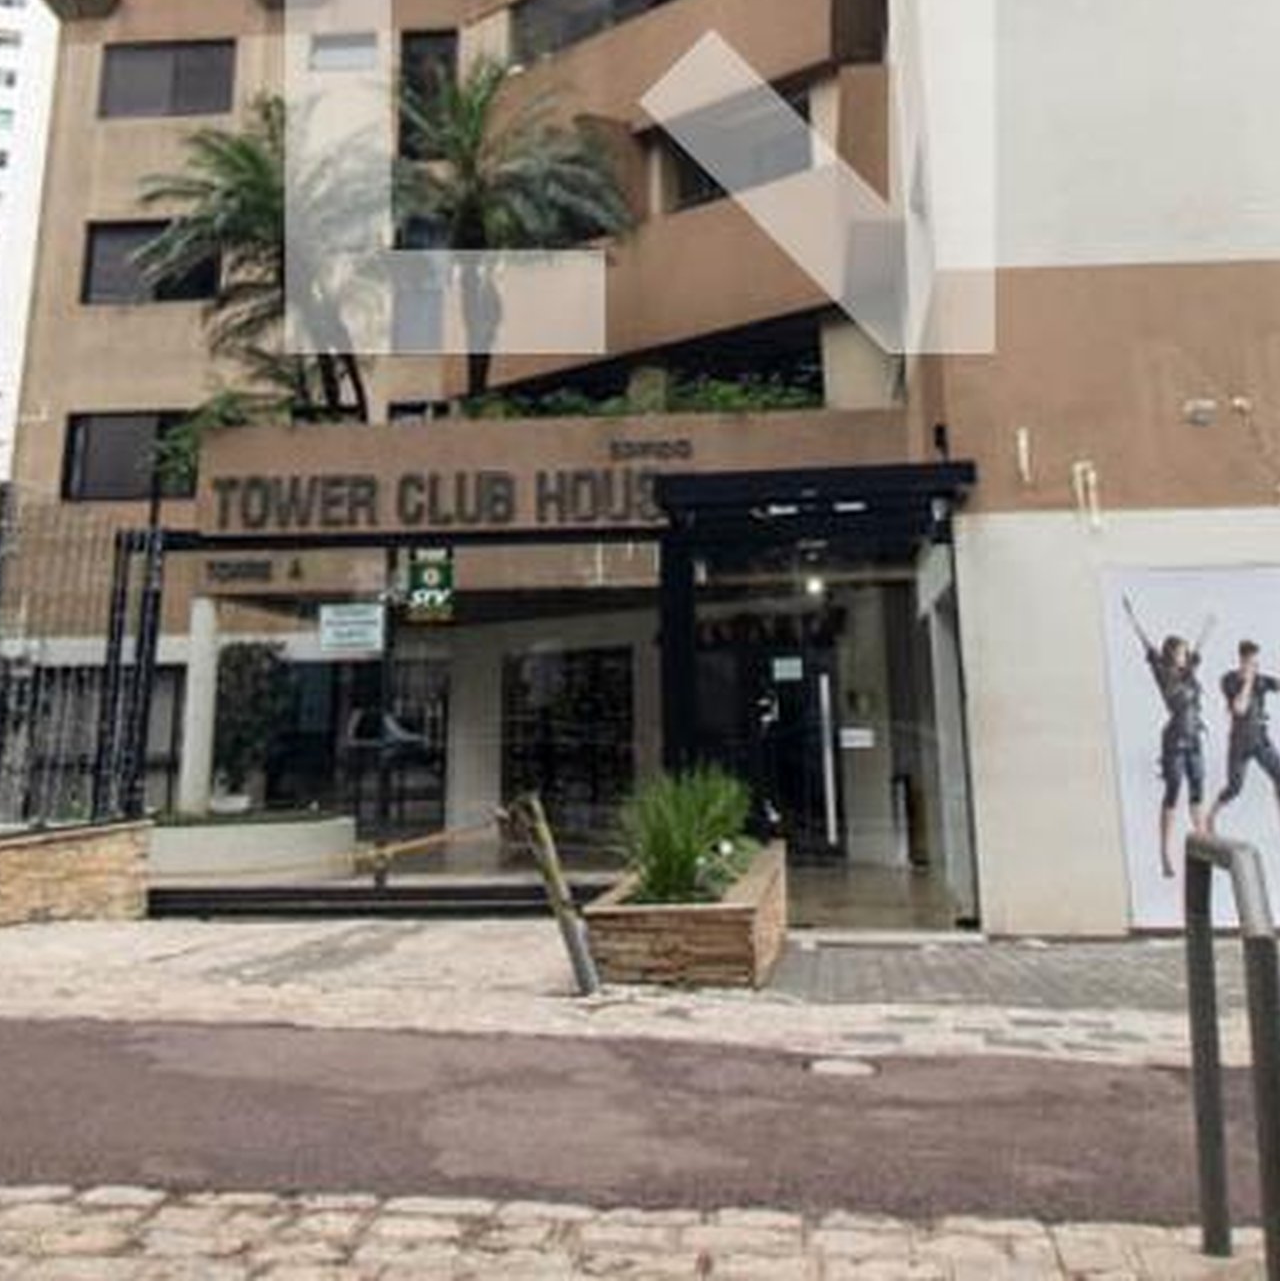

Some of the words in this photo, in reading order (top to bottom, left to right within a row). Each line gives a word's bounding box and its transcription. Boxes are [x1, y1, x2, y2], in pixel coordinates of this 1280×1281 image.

[210, 471, 378, 530] TOWER
[396, 471, 517, 526] CLUB
[533, 469, 666, 525] HOUS
